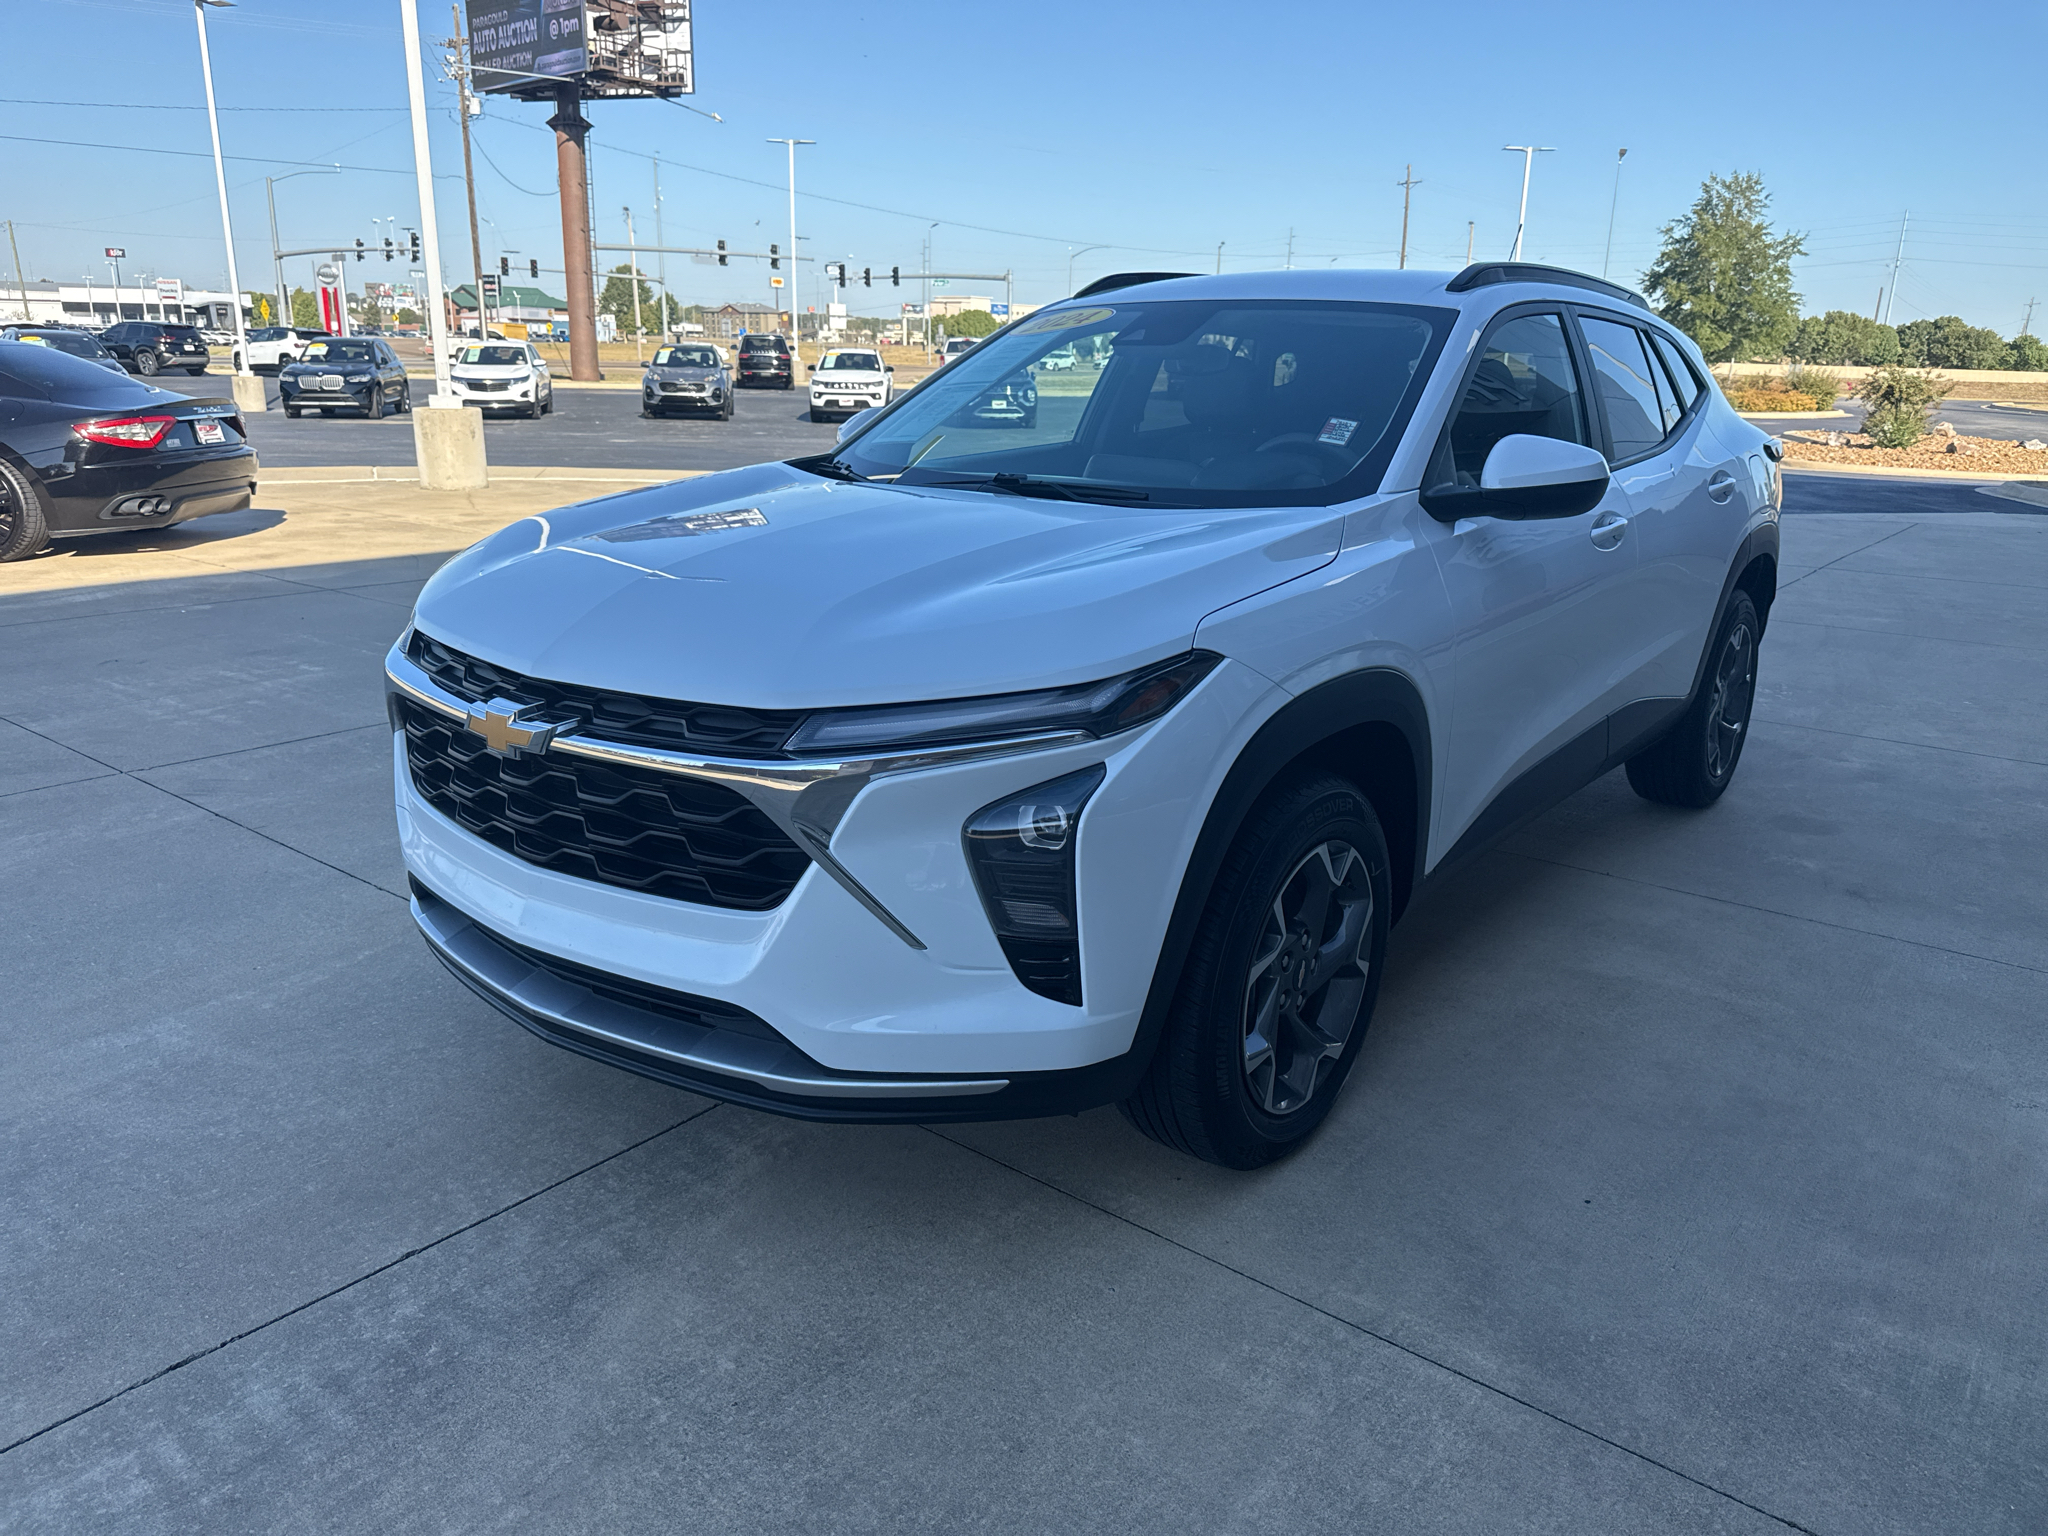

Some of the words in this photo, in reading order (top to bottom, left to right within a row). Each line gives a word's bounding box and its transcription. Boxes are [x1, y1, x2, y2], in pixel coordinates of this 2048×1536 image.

[472, 9, 508, 29] PARAGOULD
[549, 19, 559, 40] @
[559, 17, 580, 38] 1pm
[473, 27, 498, 55] AUTO
[498, 16, 538, 50] AUCTION
[502, 49, 533, 70] AUCTION
[1019, 310, 1103, 333] 2024
